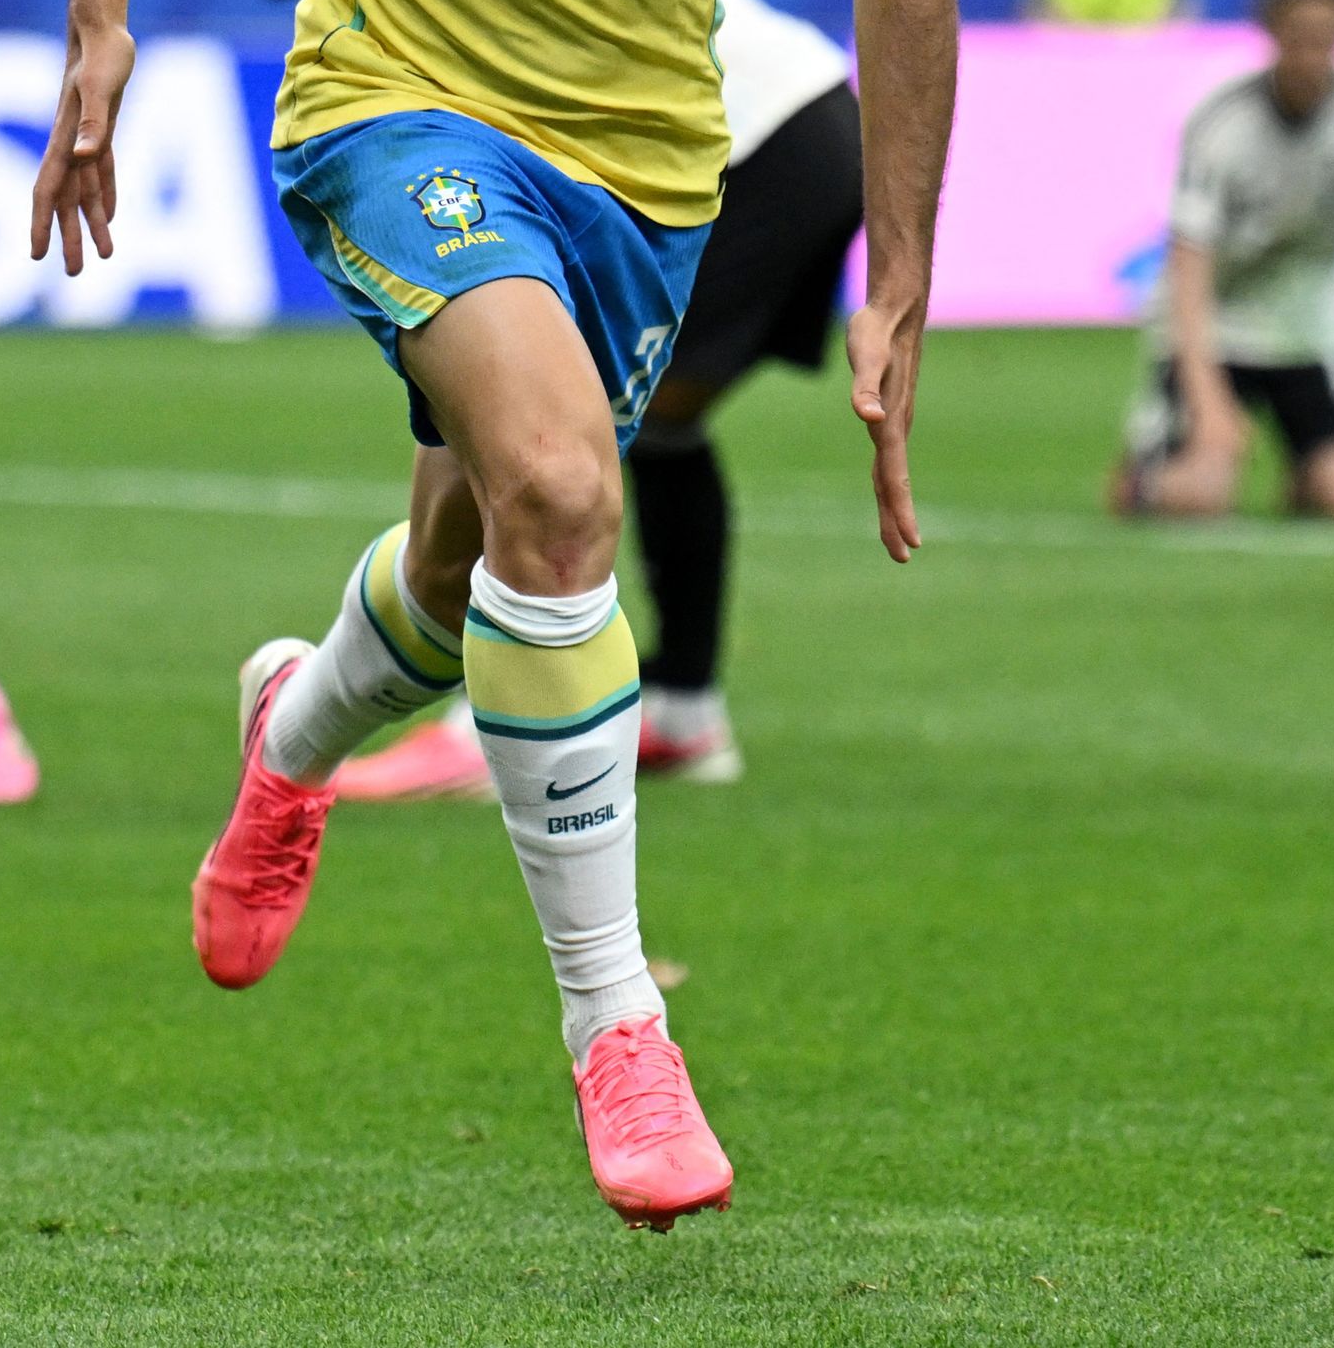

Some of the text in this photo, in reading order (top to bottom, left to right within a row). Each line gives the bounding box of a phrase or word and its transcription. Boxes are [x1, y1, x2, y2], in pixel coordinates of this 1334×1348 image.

[438, 196, 464, 207] CBF
[435, 231, 505, 258] BRASIL
[548, 803, 618, 834] BRASIL
